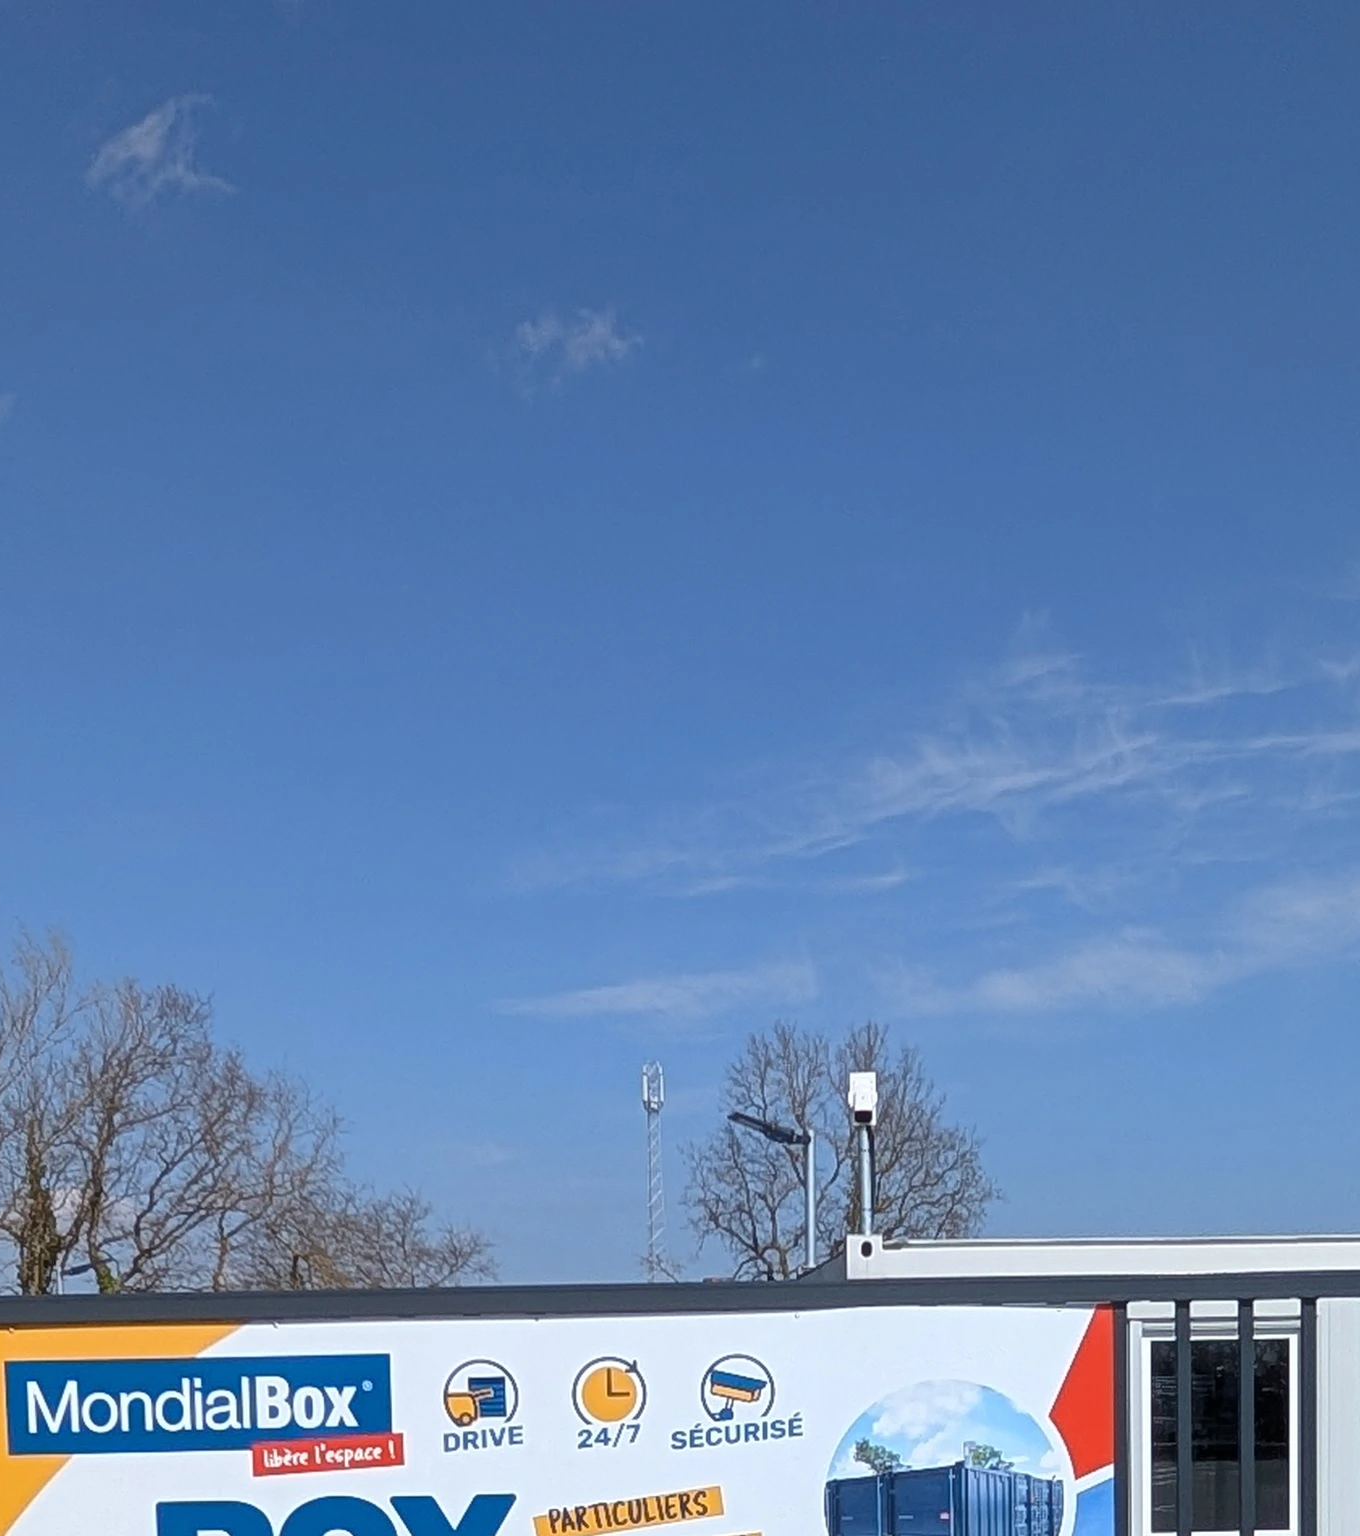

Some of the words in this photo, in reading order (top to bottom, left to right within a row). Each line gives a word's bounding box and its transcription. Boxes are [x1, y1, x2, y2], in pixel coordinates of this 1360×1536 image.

[443, 1425, 525, 1452] DRIVE
[577, 1424, 641, 1449] 24/7
[670, 1412, 804, 1450] SÉCURISÉ
[264, 1447, 308, 1468] libère
[315, 1443, 382, 1465] l'espace
[548, 1490, 708, 1534] PARTICULIERS
